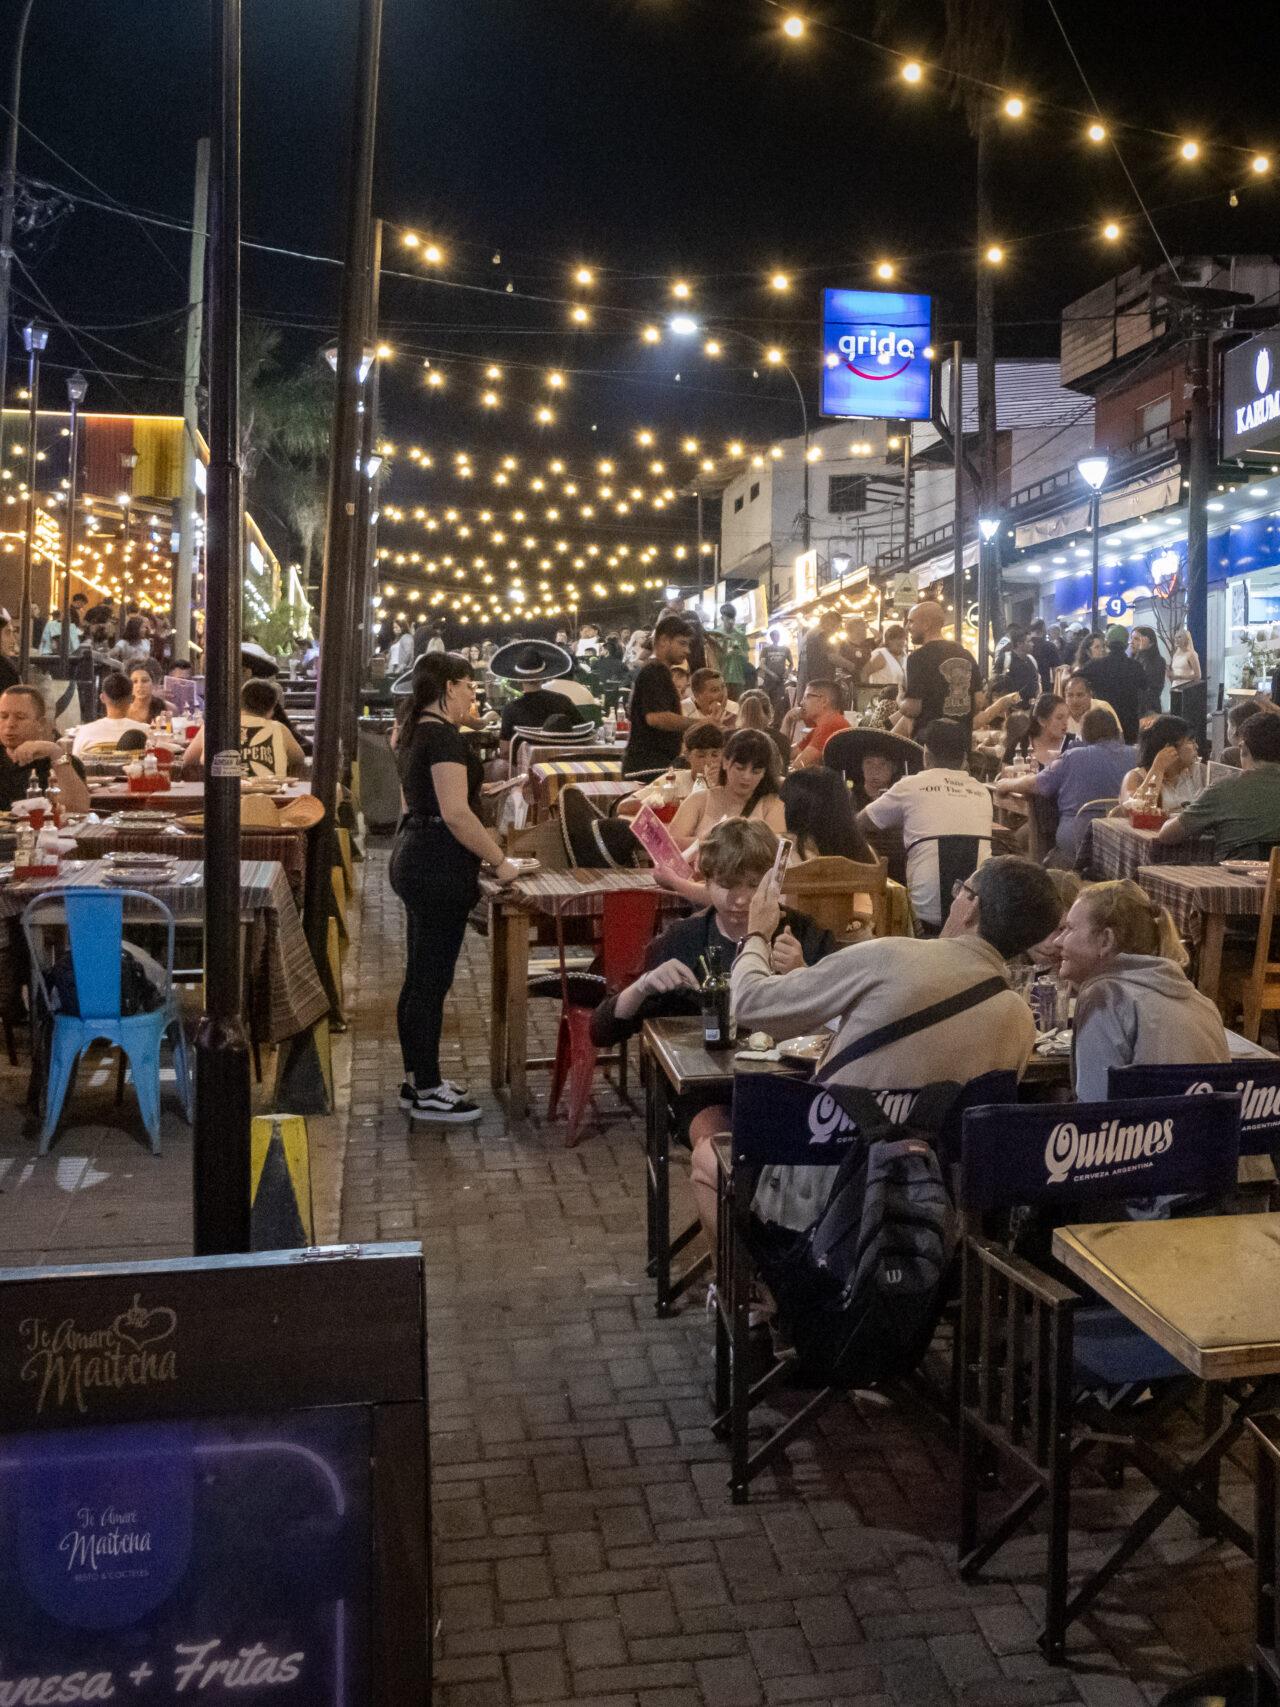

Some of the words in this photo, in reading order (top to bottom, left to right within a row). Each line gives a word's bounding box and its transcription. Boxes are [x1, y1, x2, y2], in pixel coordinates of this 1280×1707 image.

[838, 330, 914, 361] grido
[240, 744, 274, 765] PERS
[1044, 1119, 1174, 1185] Quilmes
[1074, 1171, 1110, 1183] CERVEZA
[1112, 1161, 1154, 1176] ARGENTINA
[20, 1347, 178, 1414] Maitena
[59, 1527, 152, 1571] Maitena
[174, 1639, 305, 1691] Fritas
